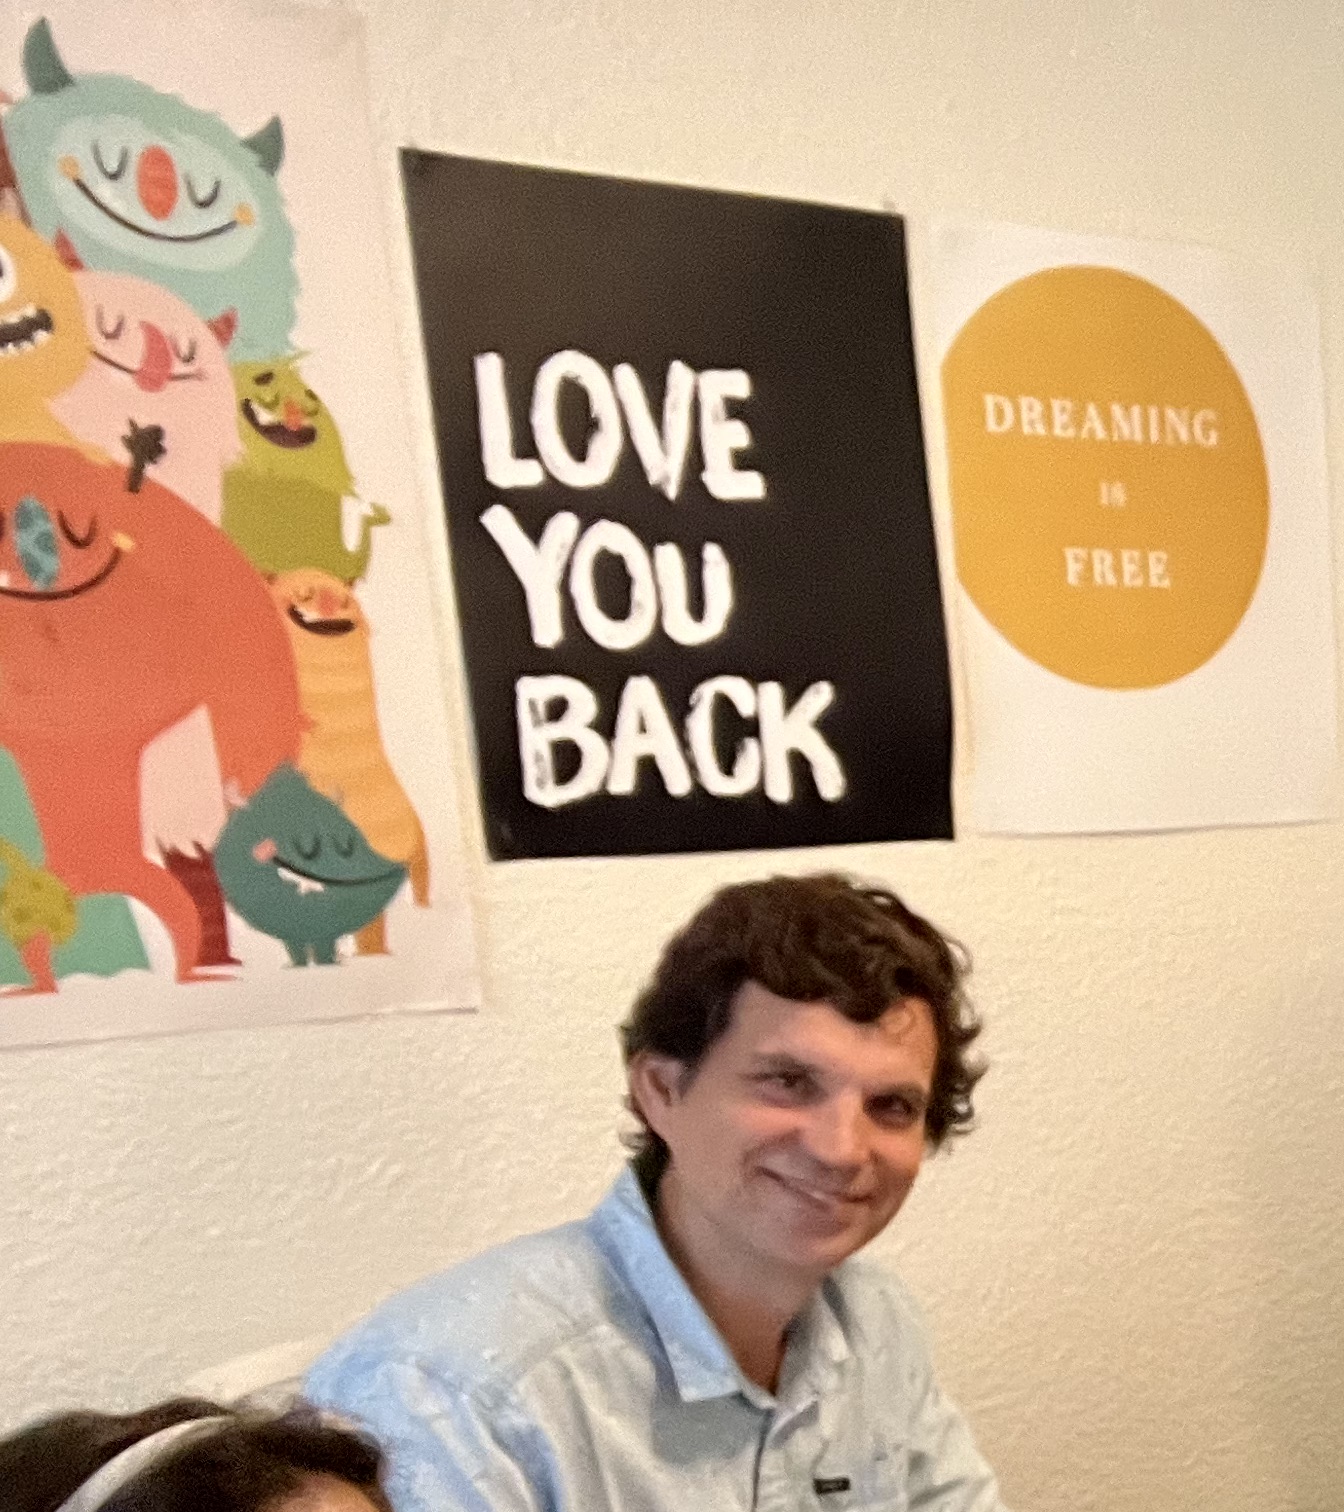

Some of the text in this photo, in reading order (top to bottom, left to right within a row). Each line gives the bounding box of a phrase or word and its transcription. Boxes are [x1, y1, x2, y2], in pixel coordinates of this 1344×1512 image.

[475, 349, 766, 500] LOVE
[982, 392, 1220, 447] DREAMING
[480, 504, 734, 651] YOU
[1062, 546, 1172, 588] FREE
[515, 675, 847, 809] BACK
